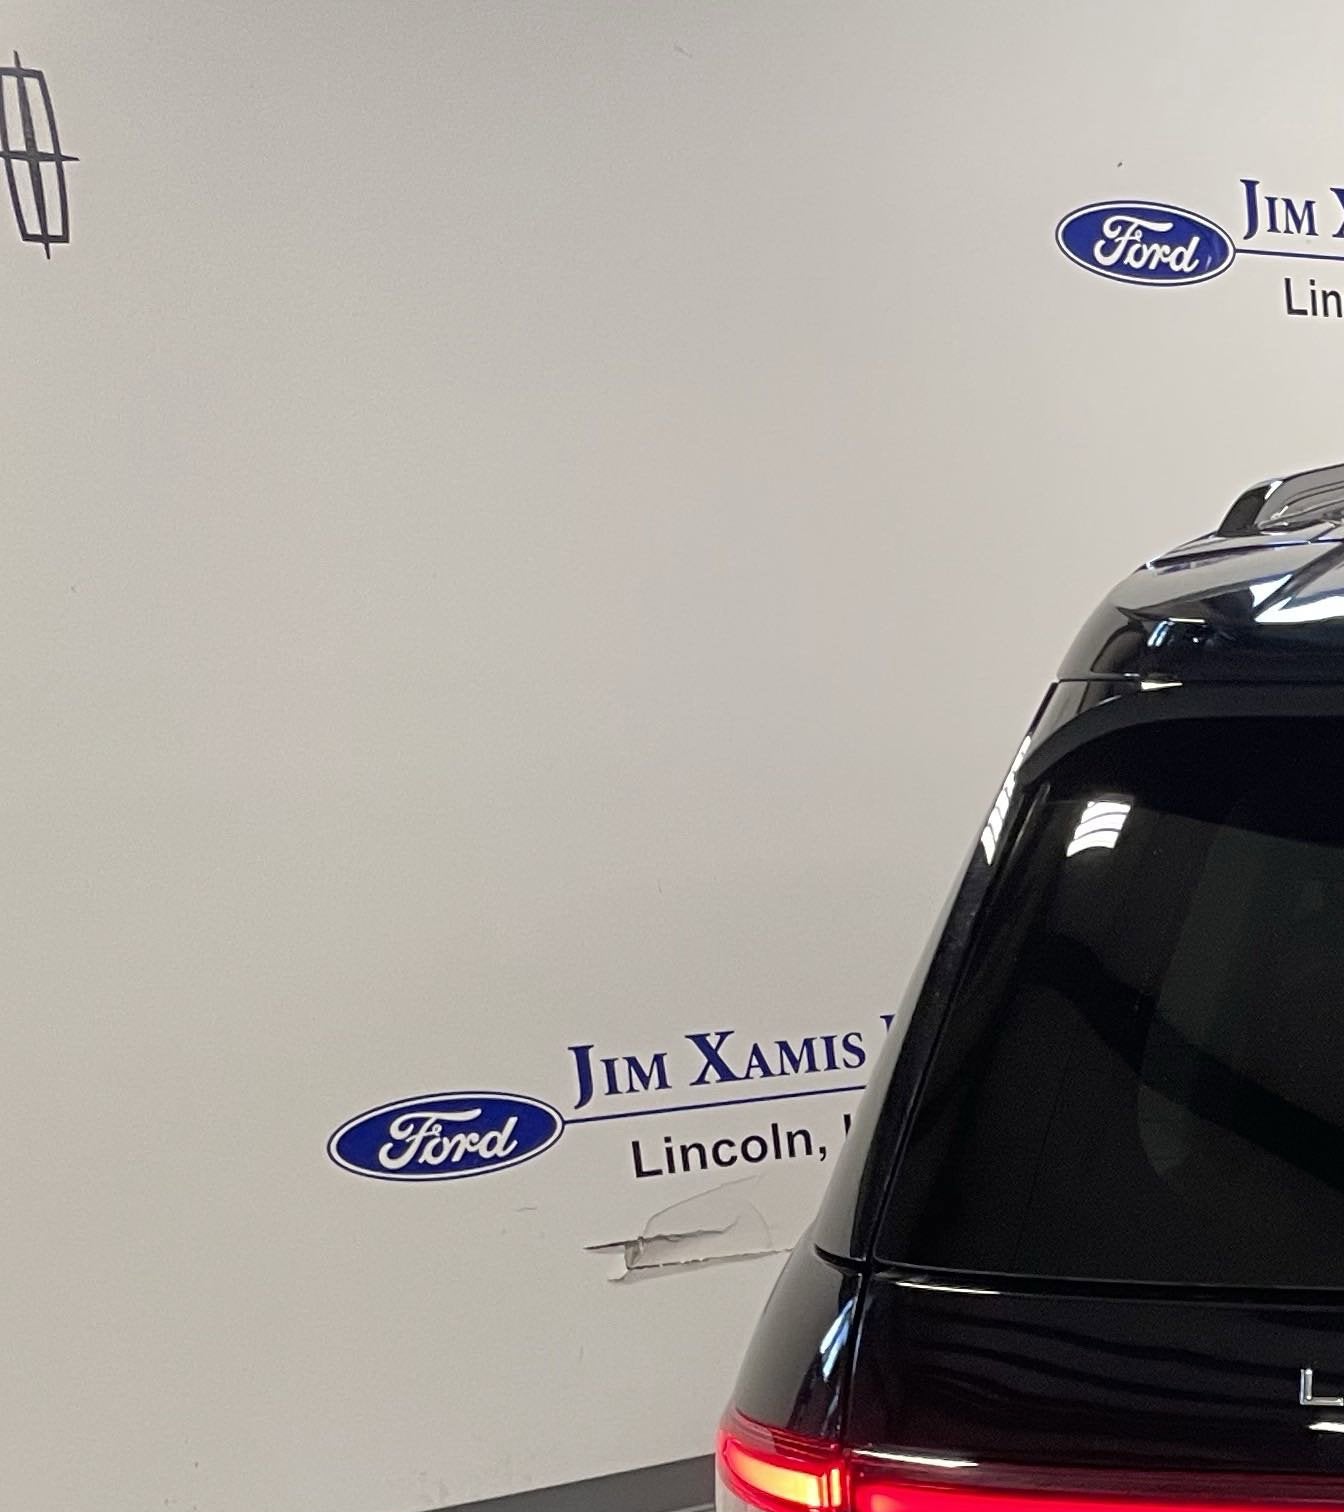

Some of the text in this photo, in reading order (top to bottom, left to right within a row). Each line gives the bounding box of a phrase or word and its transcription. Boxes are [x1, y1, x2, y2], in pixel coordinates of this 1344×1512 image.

[1239, 178, 1318, 241] JIM
[567, 1029, 868, 1110] JIM XAMIS
[630, 1122, 828, 1179] Lincoln,
